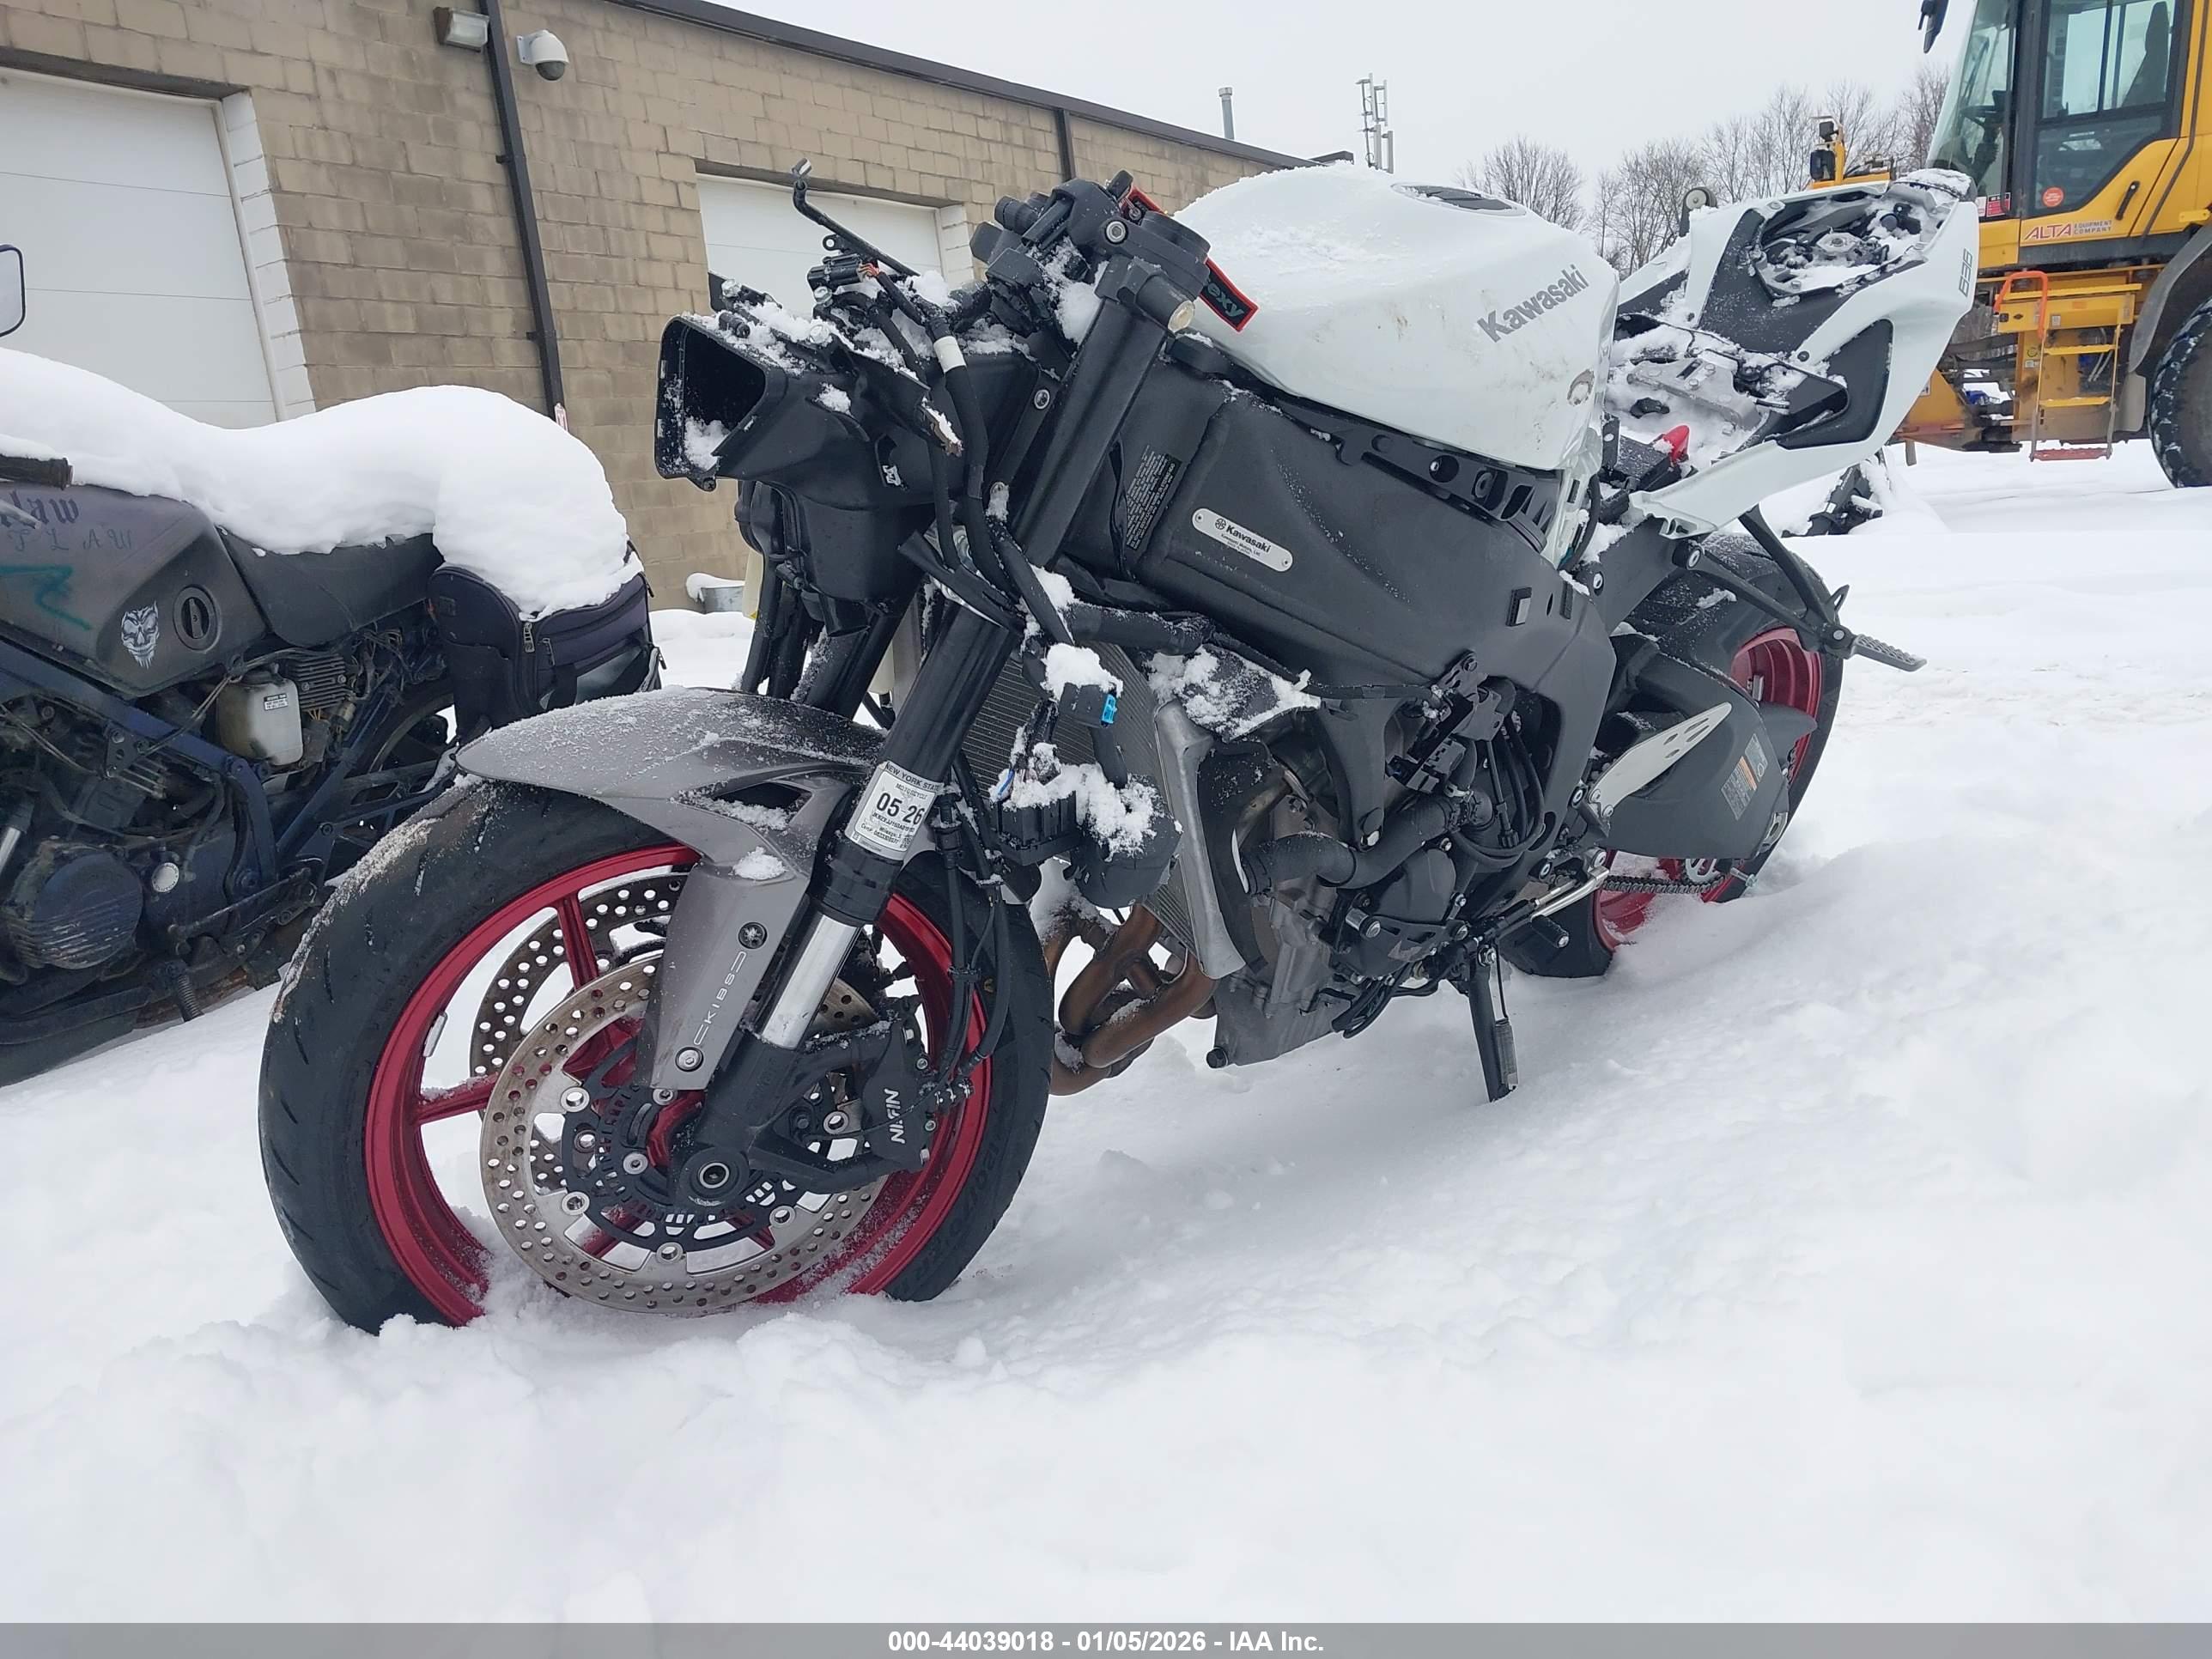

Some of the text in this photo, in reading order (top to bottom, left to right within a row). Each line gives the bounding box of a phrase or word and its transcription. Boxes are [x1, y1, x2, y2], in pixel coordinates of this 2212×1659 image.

[2024, 223, 2072, 240] ALTA
[2074, 220, 2112, 229] EQUIPMENT
[2074, 227, 2112, 235] COMPANY
[1206, 276, 1244, 318] exy
[1476, 264, 1589, 343] Kawasaki
[1225, 524, 1273, 554] Kawasaki
[884, 762, 900, 776] NEW
[901, 772, 922, 787] YORK
[704, 972, 736, 1024] KIBS
